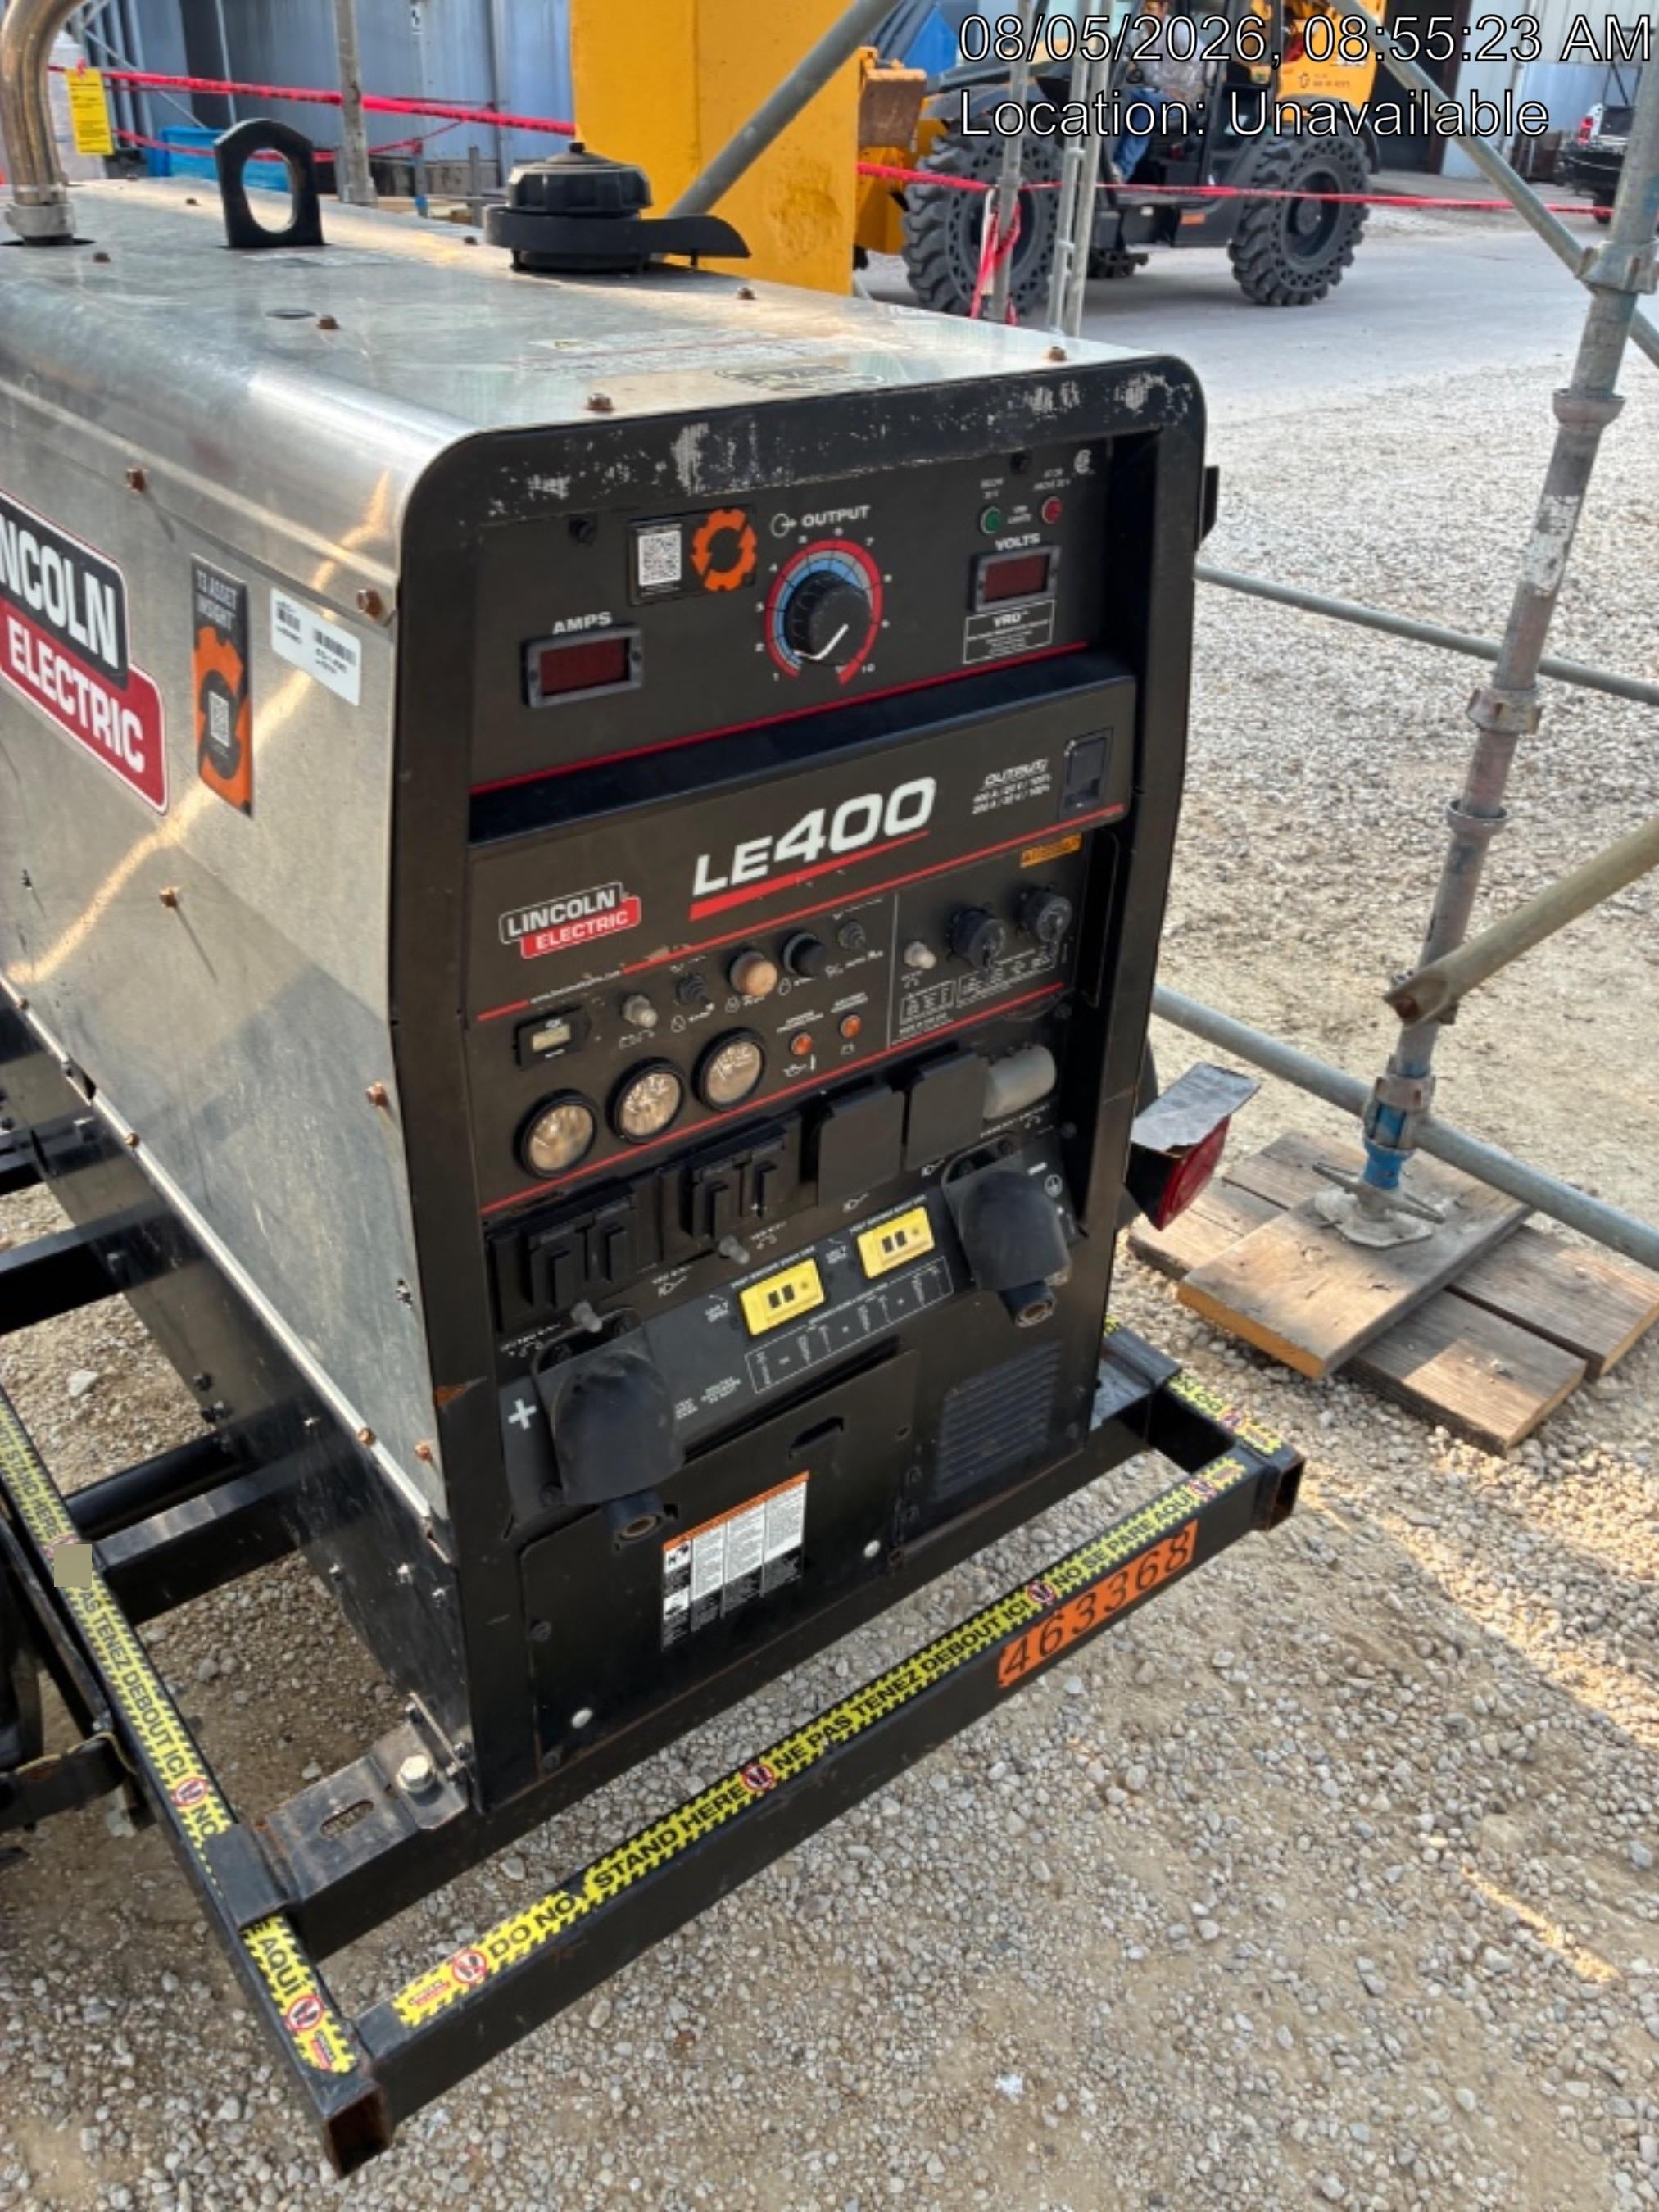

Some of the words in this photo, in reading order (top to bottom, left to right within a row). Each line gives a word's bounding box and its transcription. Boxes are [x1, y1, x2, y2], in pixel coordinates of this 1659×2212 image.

[801, 505, 871, 527] OUTPUT
[995, 533, 1040, 551] VOLTS
[0, 513, 119, 670] NCOLN
[552, 612, 612, 635] AMPS
[7, 614, 145, 773] ELECTRIC
[693, 777, 936, 896] LE400
[506, 887, 616, 938] LINCOLN
[535, 909, 629, 950] ELECTRIC
[33, 1498, 61, 1543] HERE
[1003, 1530, 1190, 1674] 463368
[1054, 1562, 1082, 1589] NO
[93, 1613, 132, 1671] TENEZ
[121, 1669, 174, 1751] DEBOUT
[163, 1748, 189, 1778] ICI
[774, 1746, 808, 1771] NE
[808, 1714, 854, 1747] PAS
[853, 1670, 919, 1719] TENEZ
[920, 1618, 1002, 1671] DEBOUT
[1003, 1600, 1028, 1621] ICI
[487, 1925, 531, 1959] DO
[593, 1829, 678, 1889] STAND
[681, 1785, 749, 1832] HERE
